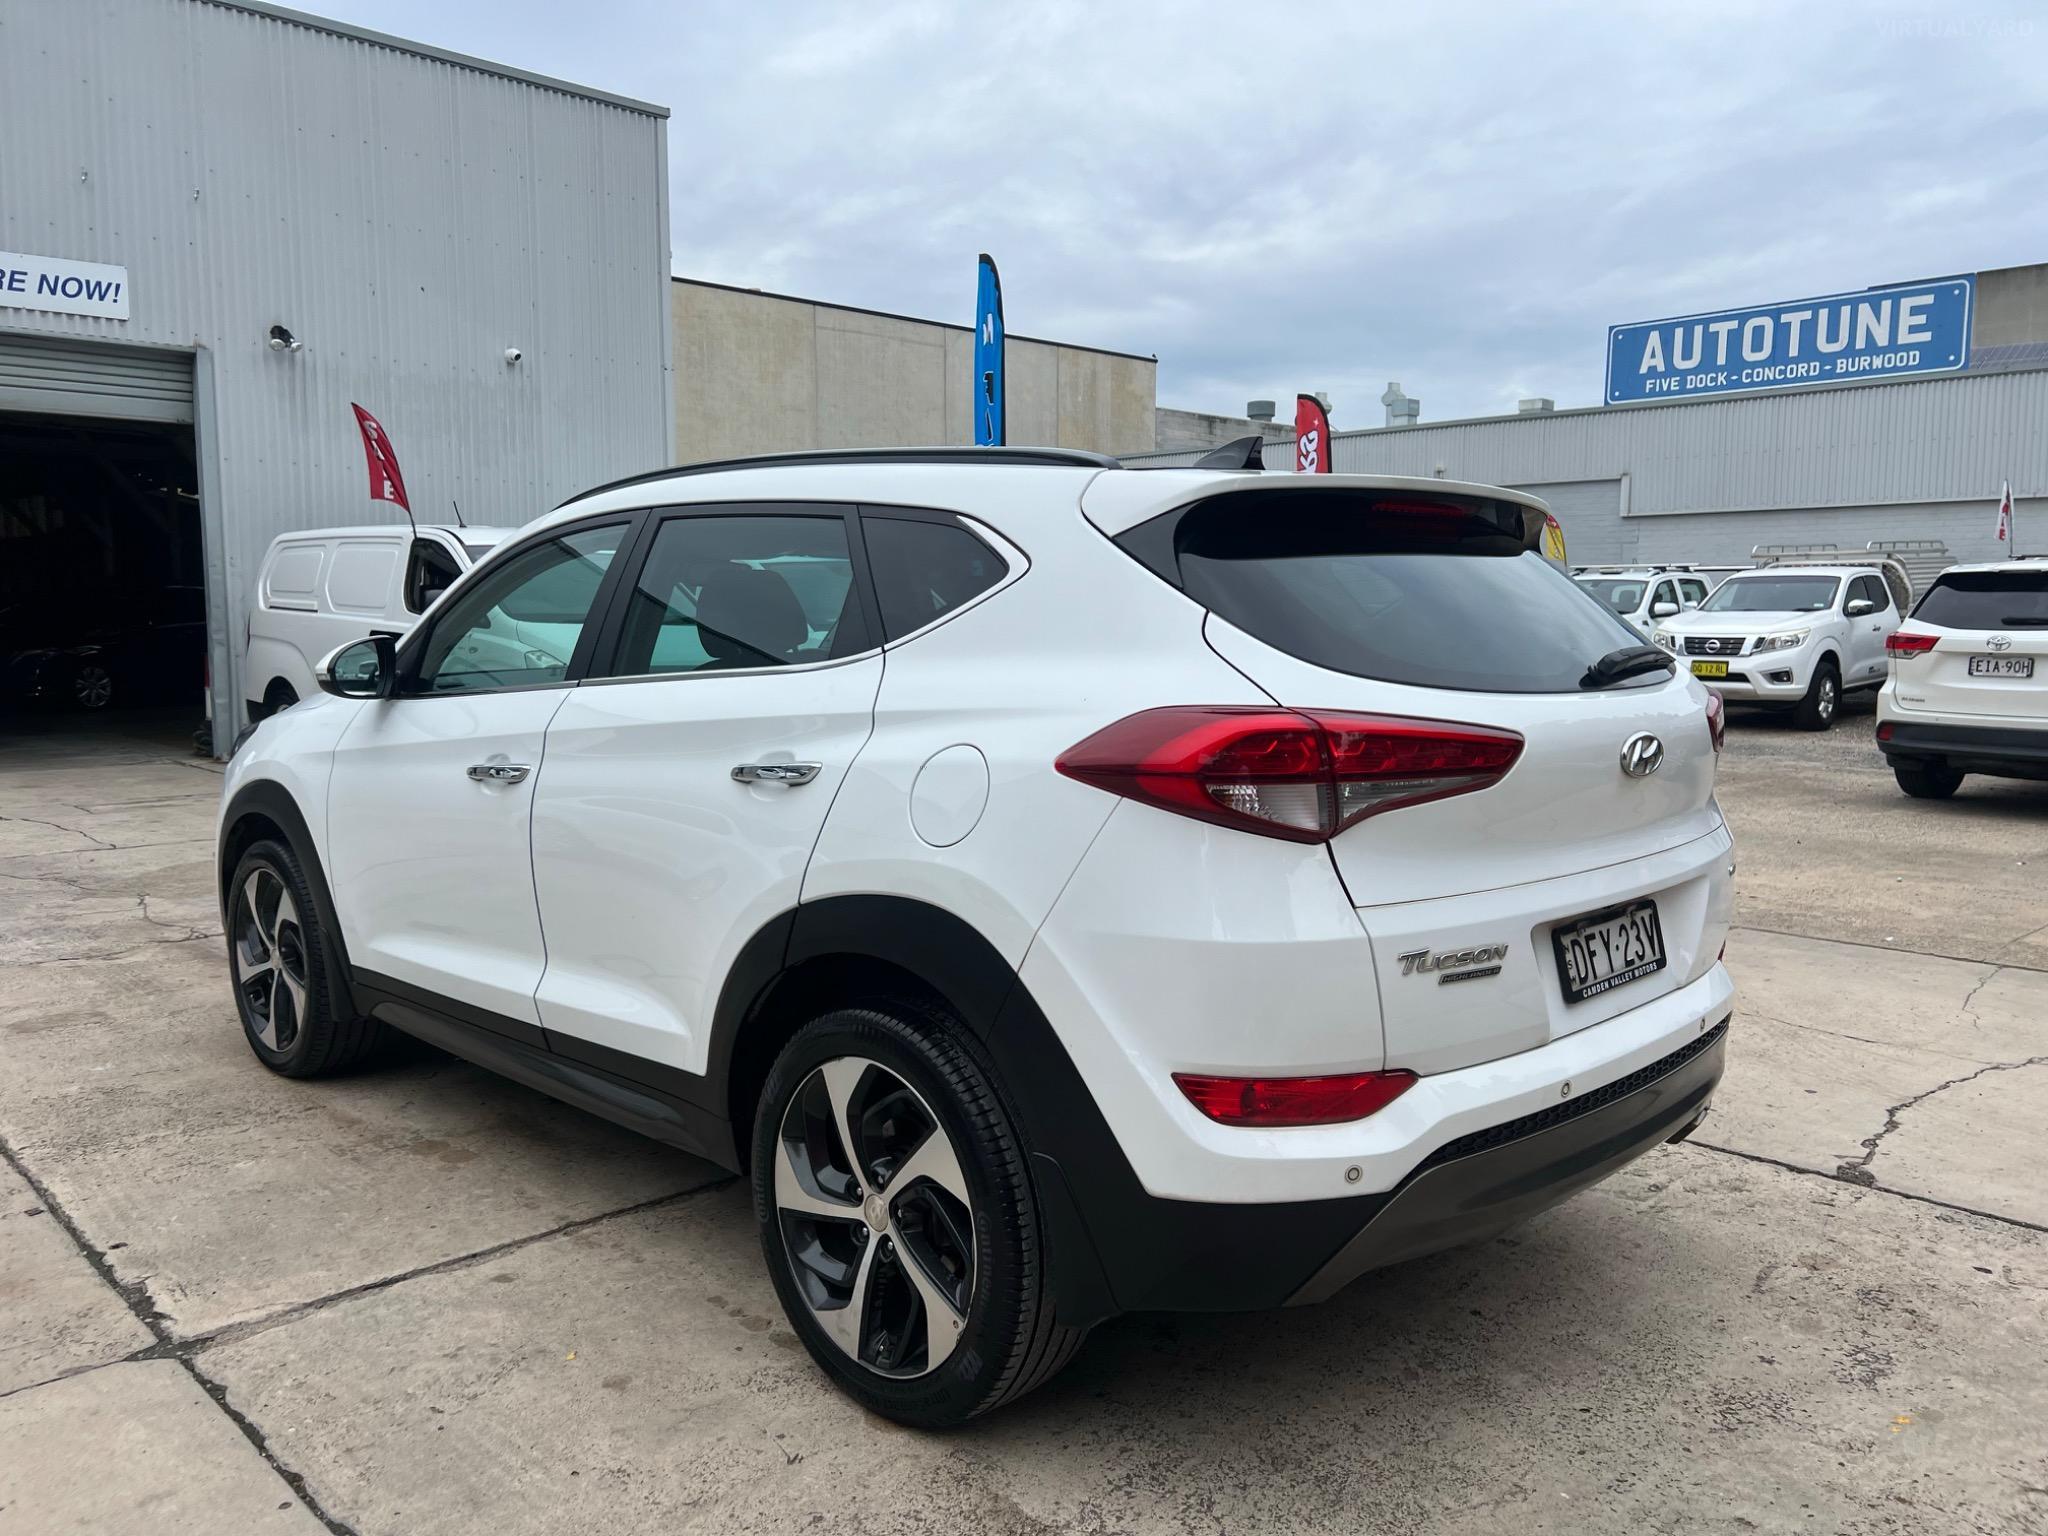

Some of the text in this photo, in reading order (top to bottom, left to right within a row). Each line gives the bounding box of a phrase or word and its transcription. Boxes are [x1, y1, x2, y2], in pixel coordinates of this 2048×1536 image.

[37, 273, 121, 304] NOW!
[1639, 294, 1935, 375] AUTOTUNE
[1645, 376, 1680, 393] FIVE
[1686, 371, 1728, 390] DOCK
[1742, 361, 1820, 383] CONCORD
[1835, 350, 1920, 373] BURWOOD
[1582, 961, 1657, 998] CAMDEN VALLEY MOTORS
